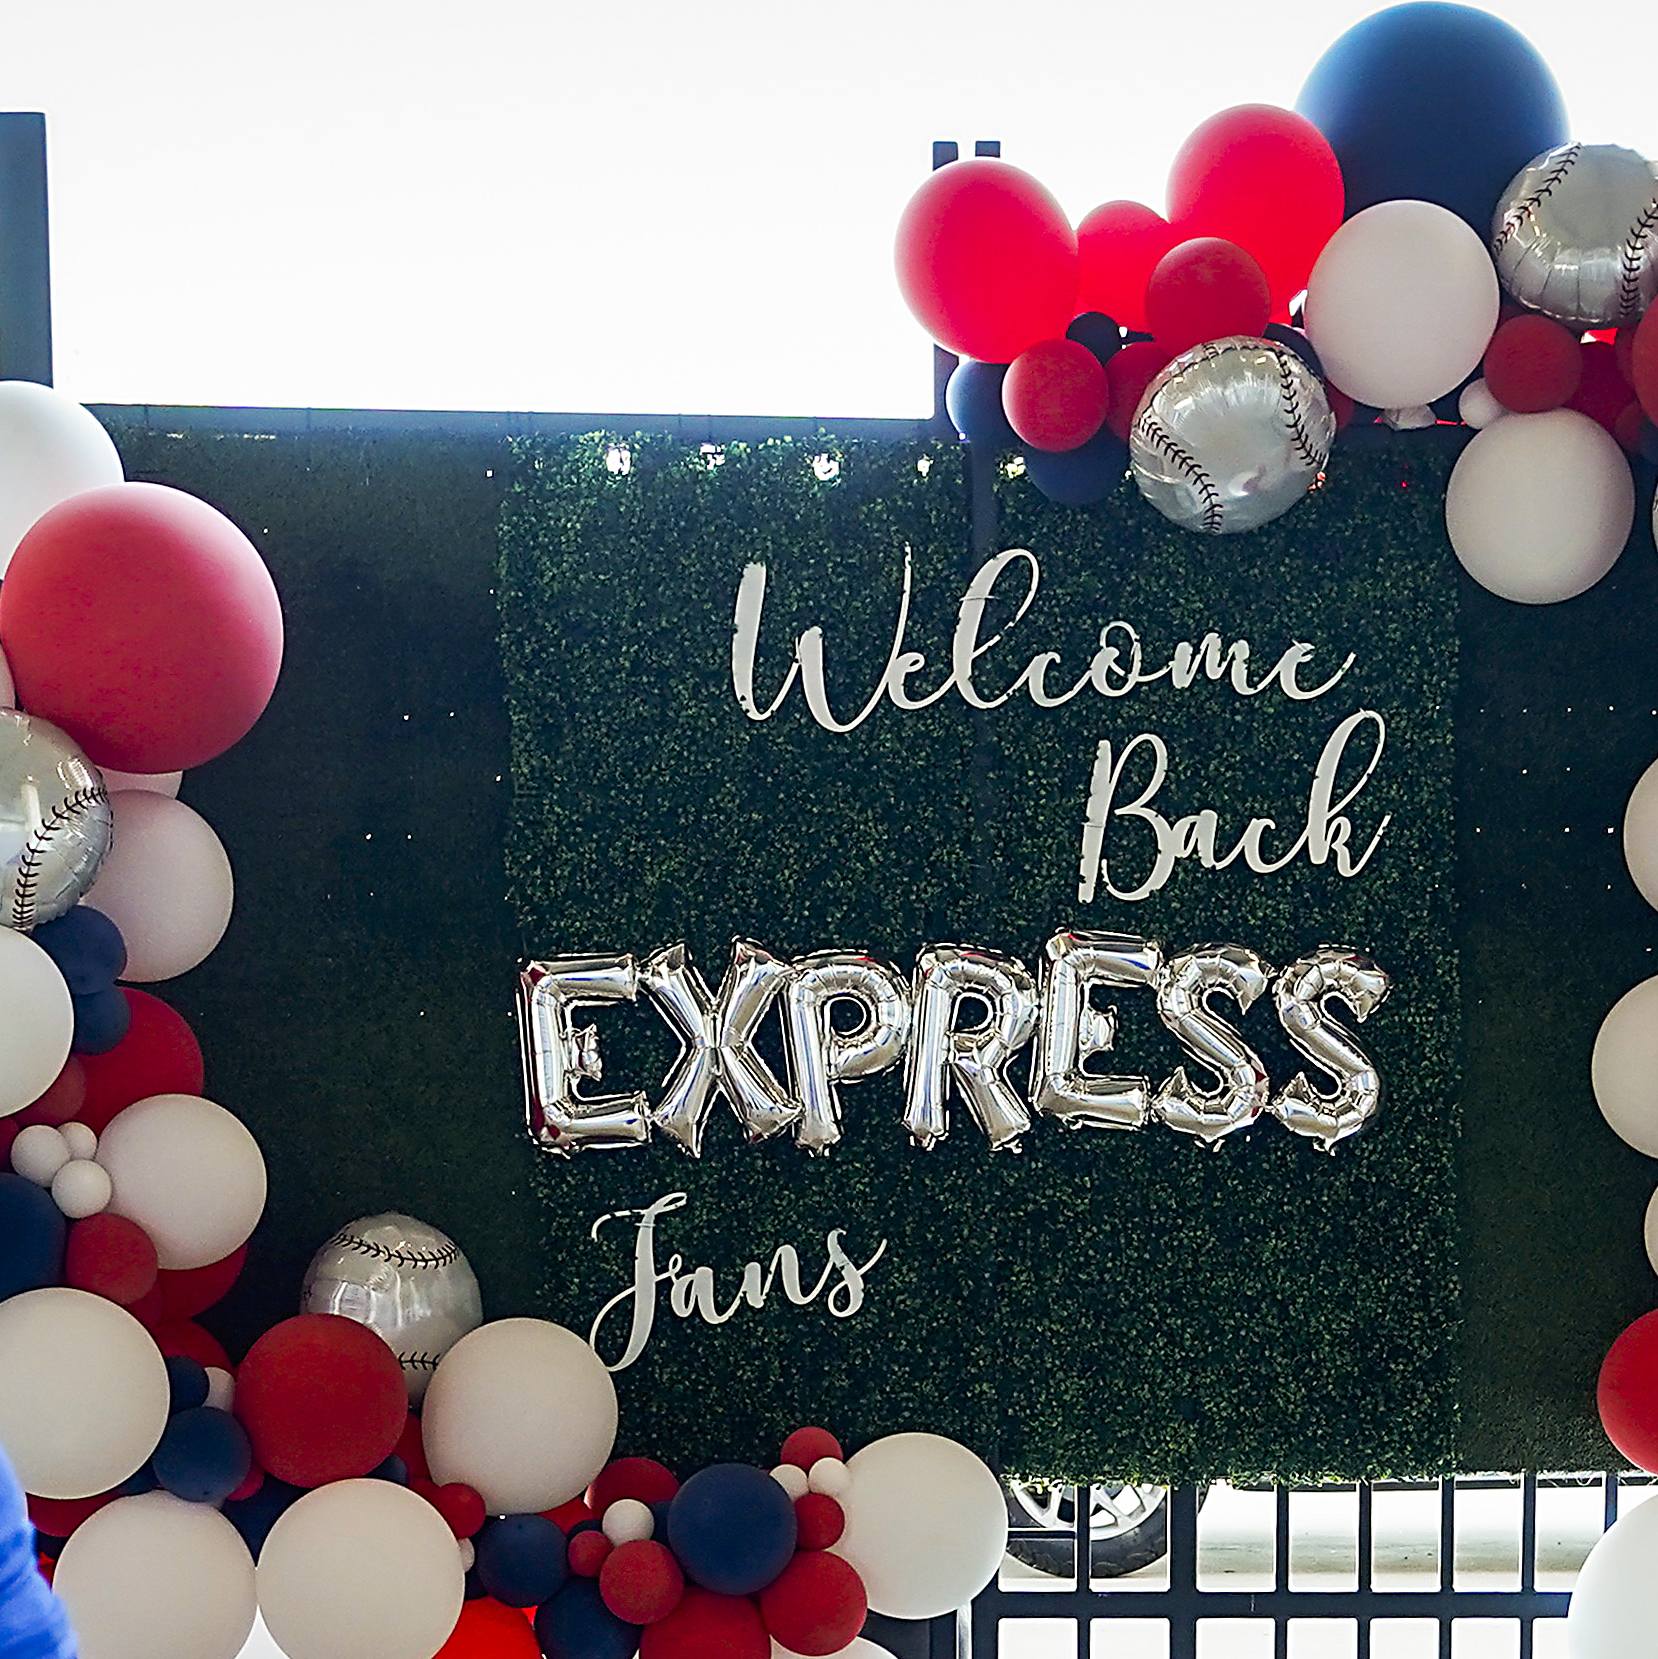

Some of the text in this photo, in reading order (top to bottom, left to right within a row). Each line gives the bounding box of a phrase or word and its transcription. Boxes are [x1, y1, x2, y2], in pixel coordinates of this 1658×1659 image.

[731, 544, 1354, 733] Welcome
[1078, 711, 1391, 903] Back
[519, 928, 1394, 1156] EXPRESS
[589, 1193, 887, 1372] Fans
